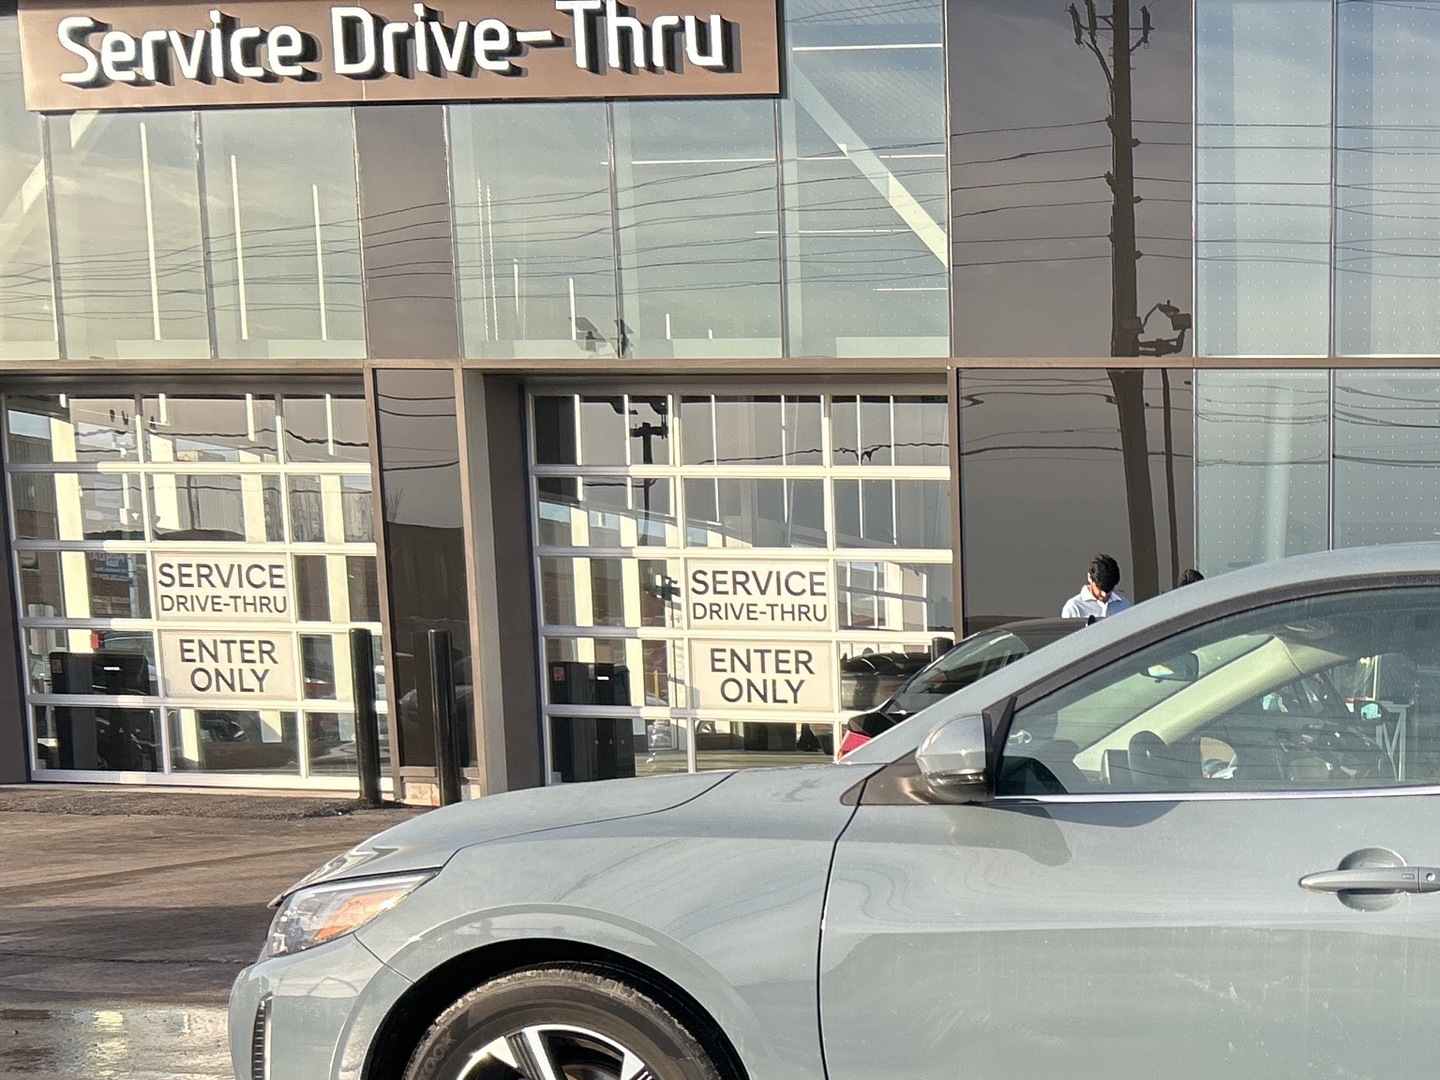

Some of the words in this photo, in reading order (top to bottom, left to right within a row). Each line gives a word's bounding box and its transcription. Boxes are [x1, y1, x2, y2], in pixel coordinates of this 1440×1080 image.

[57, 10, 303, 83] Service
[331, 0, 724, 74] Drive-Thru
[158, 562, 286, 589] SERVICE
[690, 569, 827, 597] SERVICE
[160, 594, 287, 613] DRIVE-THRU
[692, 602, 828, 622] DRIVE-THRU
[178, 638, 279, 665] ENTER
[710, 648, 816, 675] ENTER
[190, 667, 270, 693] ONLY
[720, 677, 806, 704] ONLY
